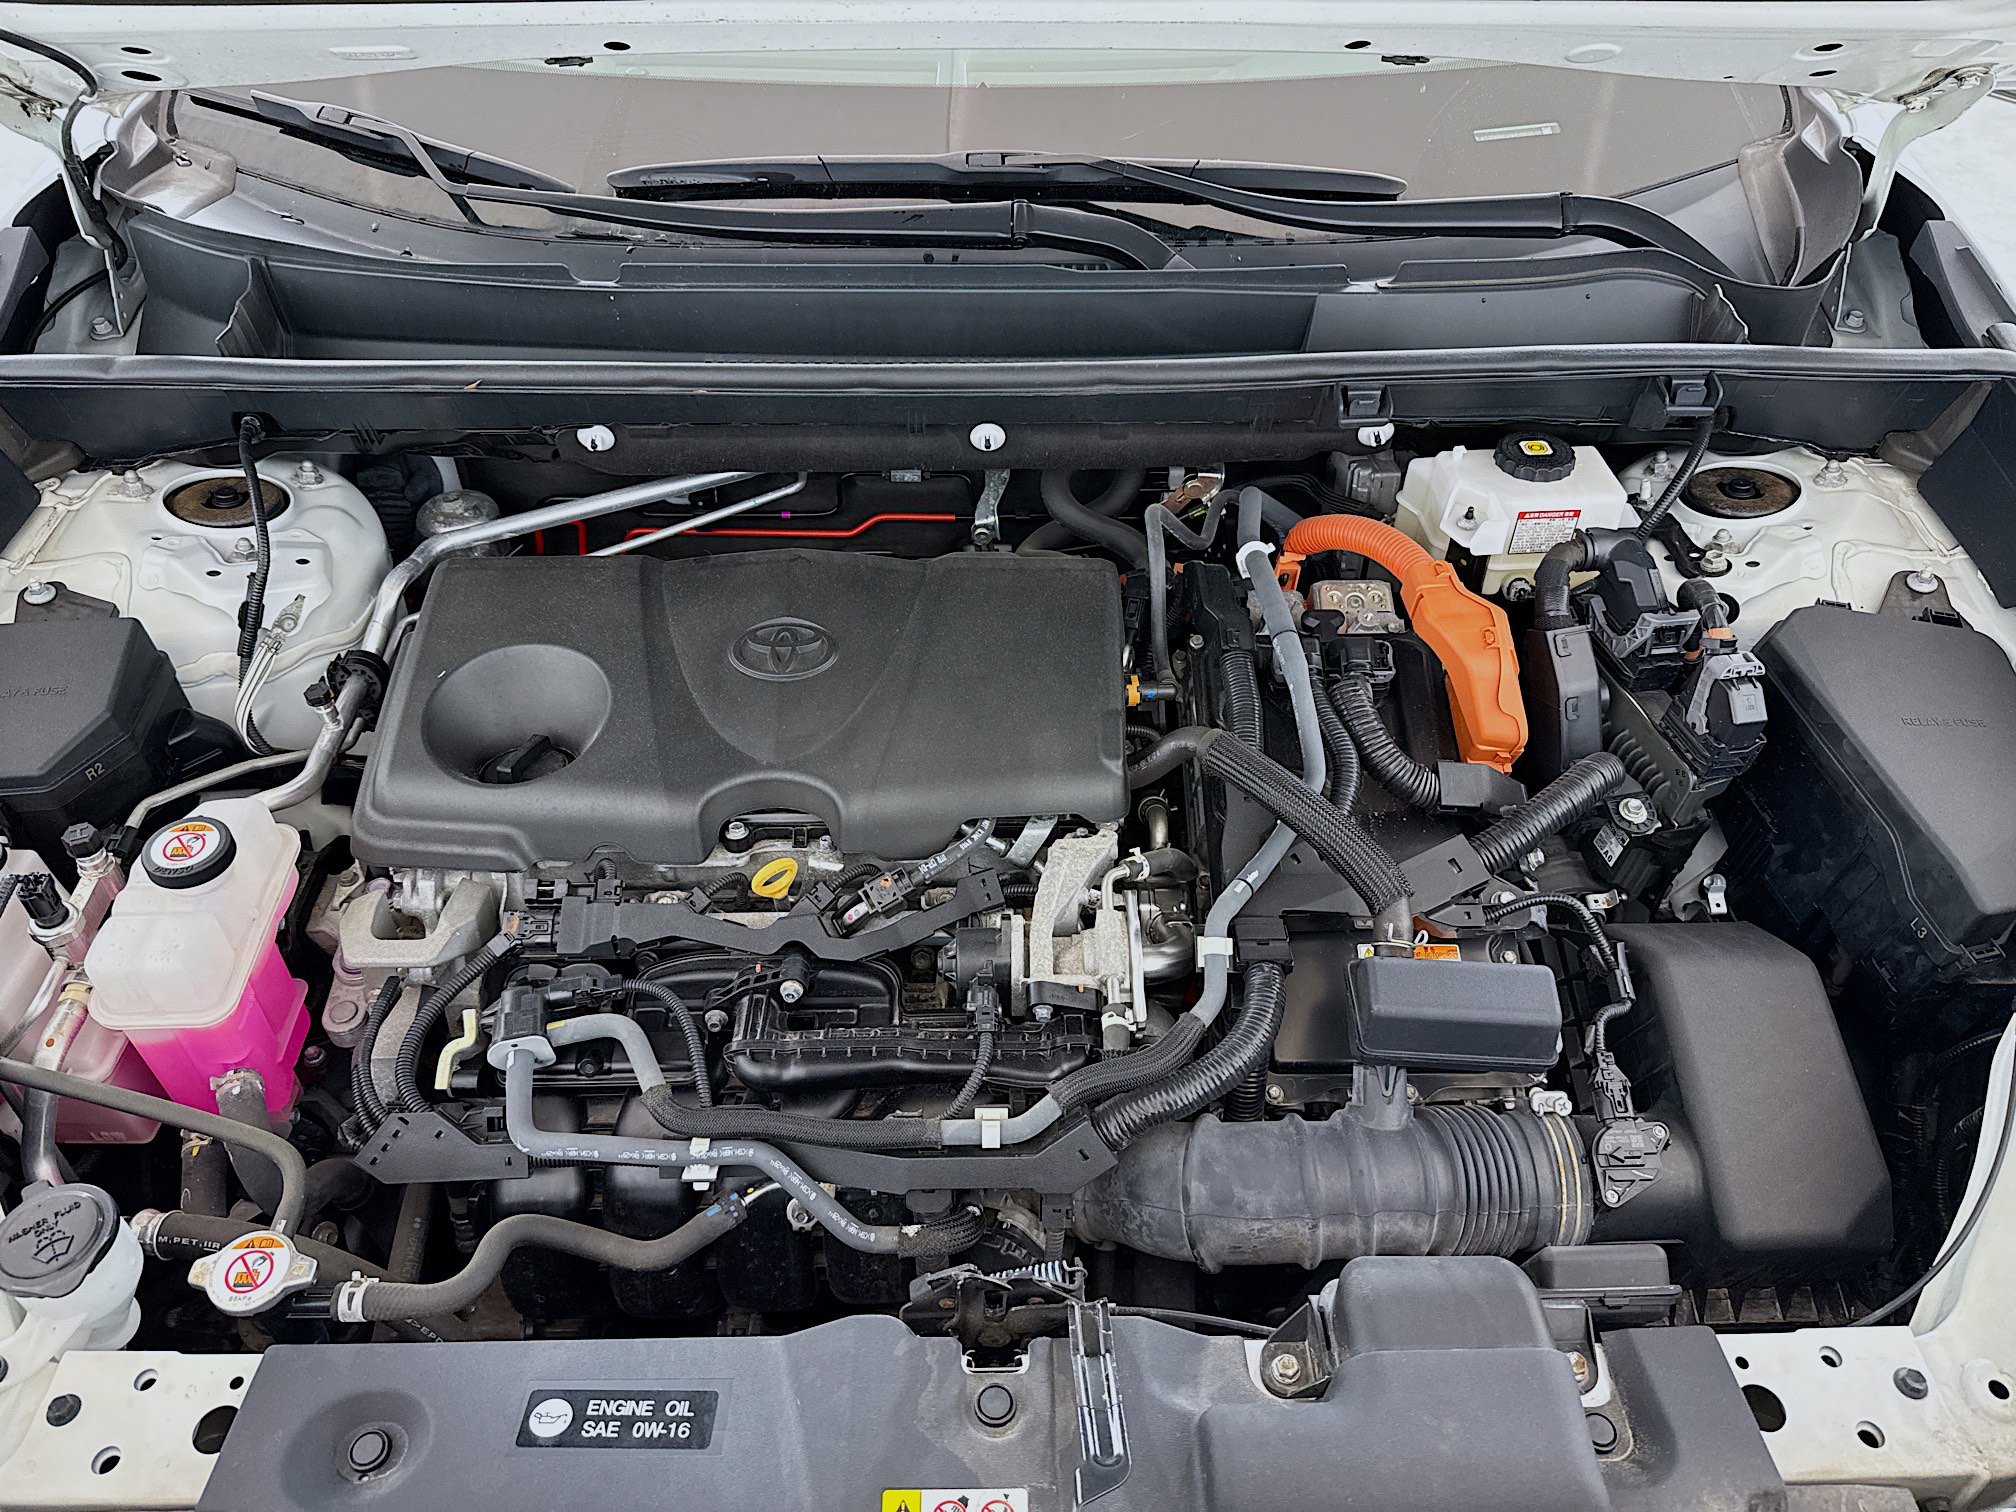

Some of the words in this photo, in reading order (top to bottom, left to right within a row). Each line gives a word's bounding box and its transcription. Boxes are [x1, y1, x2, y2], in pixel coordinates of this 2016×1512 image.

[34, 685, 69, 697] FUSE
[1901, 716, 1940, 727] RELAY
[1953, 718, 1987, 728] FUSE
[85, 762, 105, 781] R2
[153, 865, 195, 876] DENSO
[1910, 917, 1928, 939] L3
[54, 1201, 81, 1220] FLUID
[34, 1219, 59, 1238] ONLY
[586, 1400, 654, 1416] ENGINE
[665, 1401, 695, 1417] OIL
[581, 1421, 621, 1438] SAE
[632, 1421, 691, 1438] 0W-16
